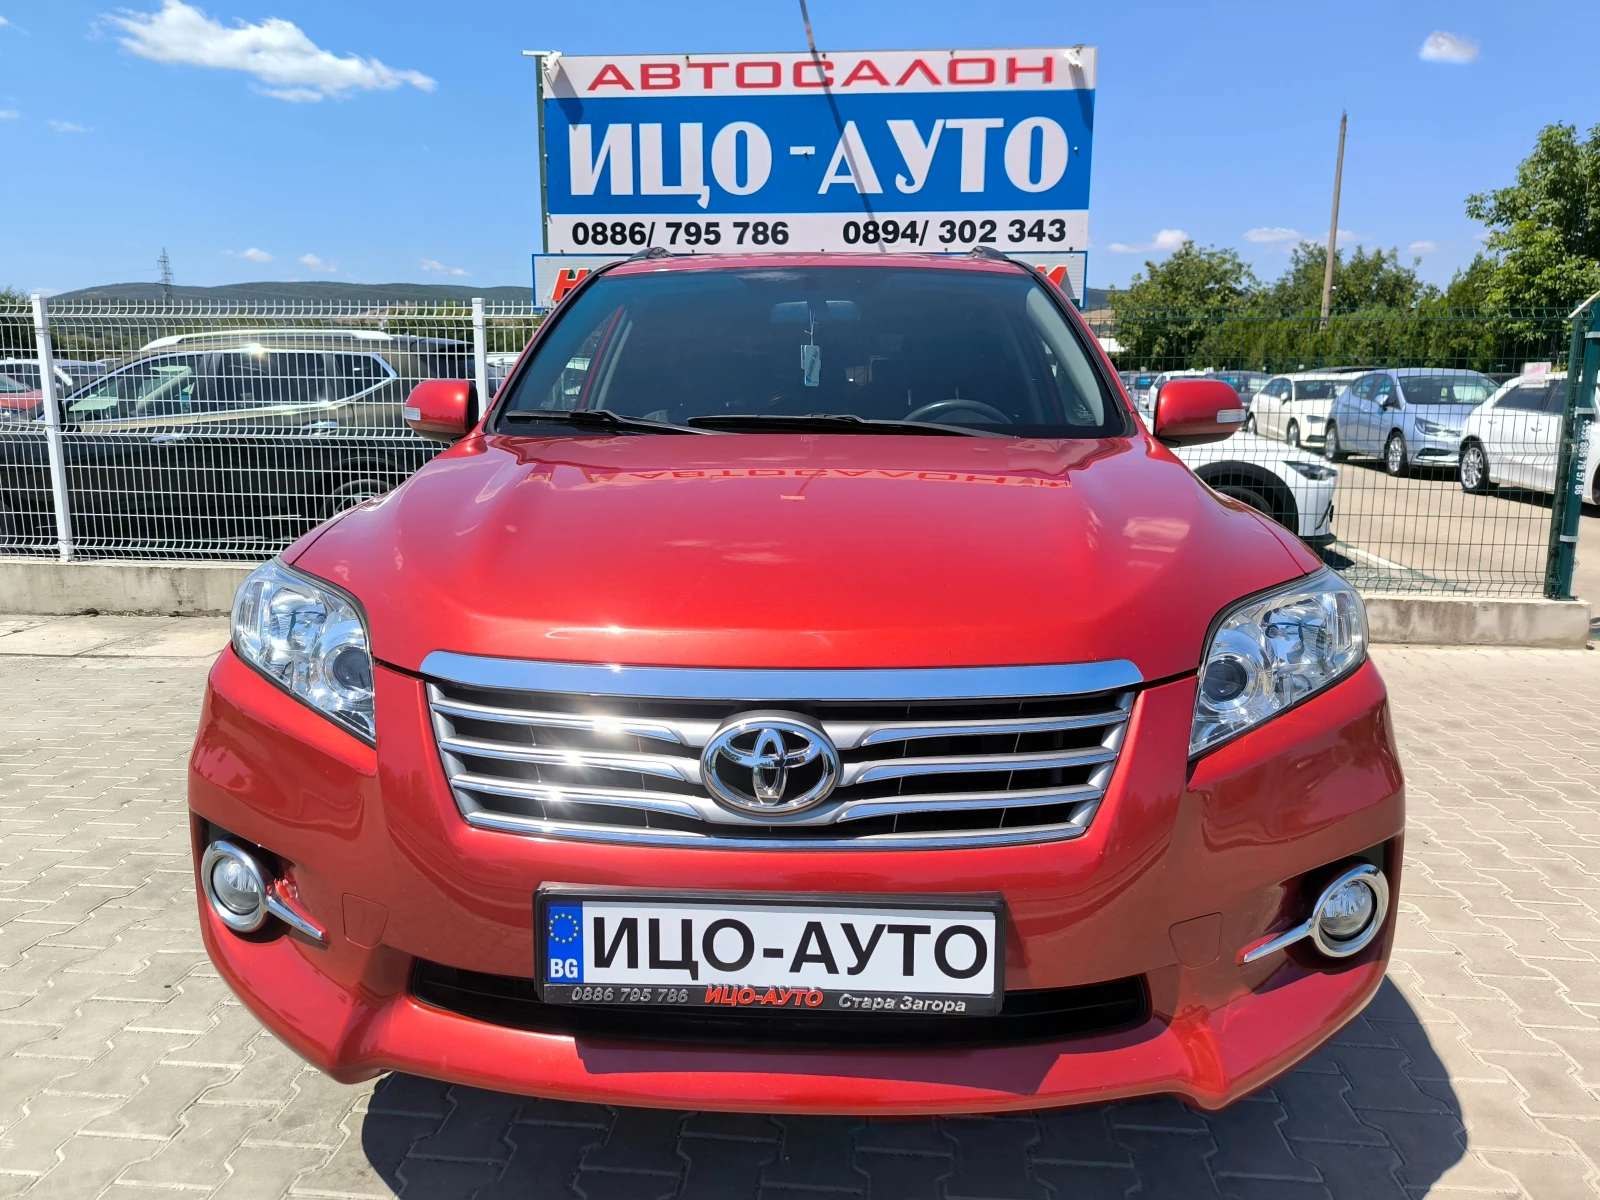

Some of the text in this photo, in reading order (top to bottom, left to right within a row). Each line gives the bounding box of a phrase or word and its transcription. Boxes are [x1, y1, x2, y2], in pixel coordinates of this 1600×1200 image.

[587, 56, 1054, 91] АВТОСАЛОН
[571, 221, 789, 247] 0886/ 795 786
[843, 218, 1066, 246] 0894/ 302 343
[1577, 459, 1587, 470] 79
[1576, 472, 1586, 481] 57
[593, 916, 988, 981] ИЦО-АУТО
[550, 958, 579, 978] BG
[571, 987, 689, 1004] 0886 795 786
[704, 984, 823, 1007] ИЦО-АУТО
[838, 993, 966, 1013] Стара Загора
